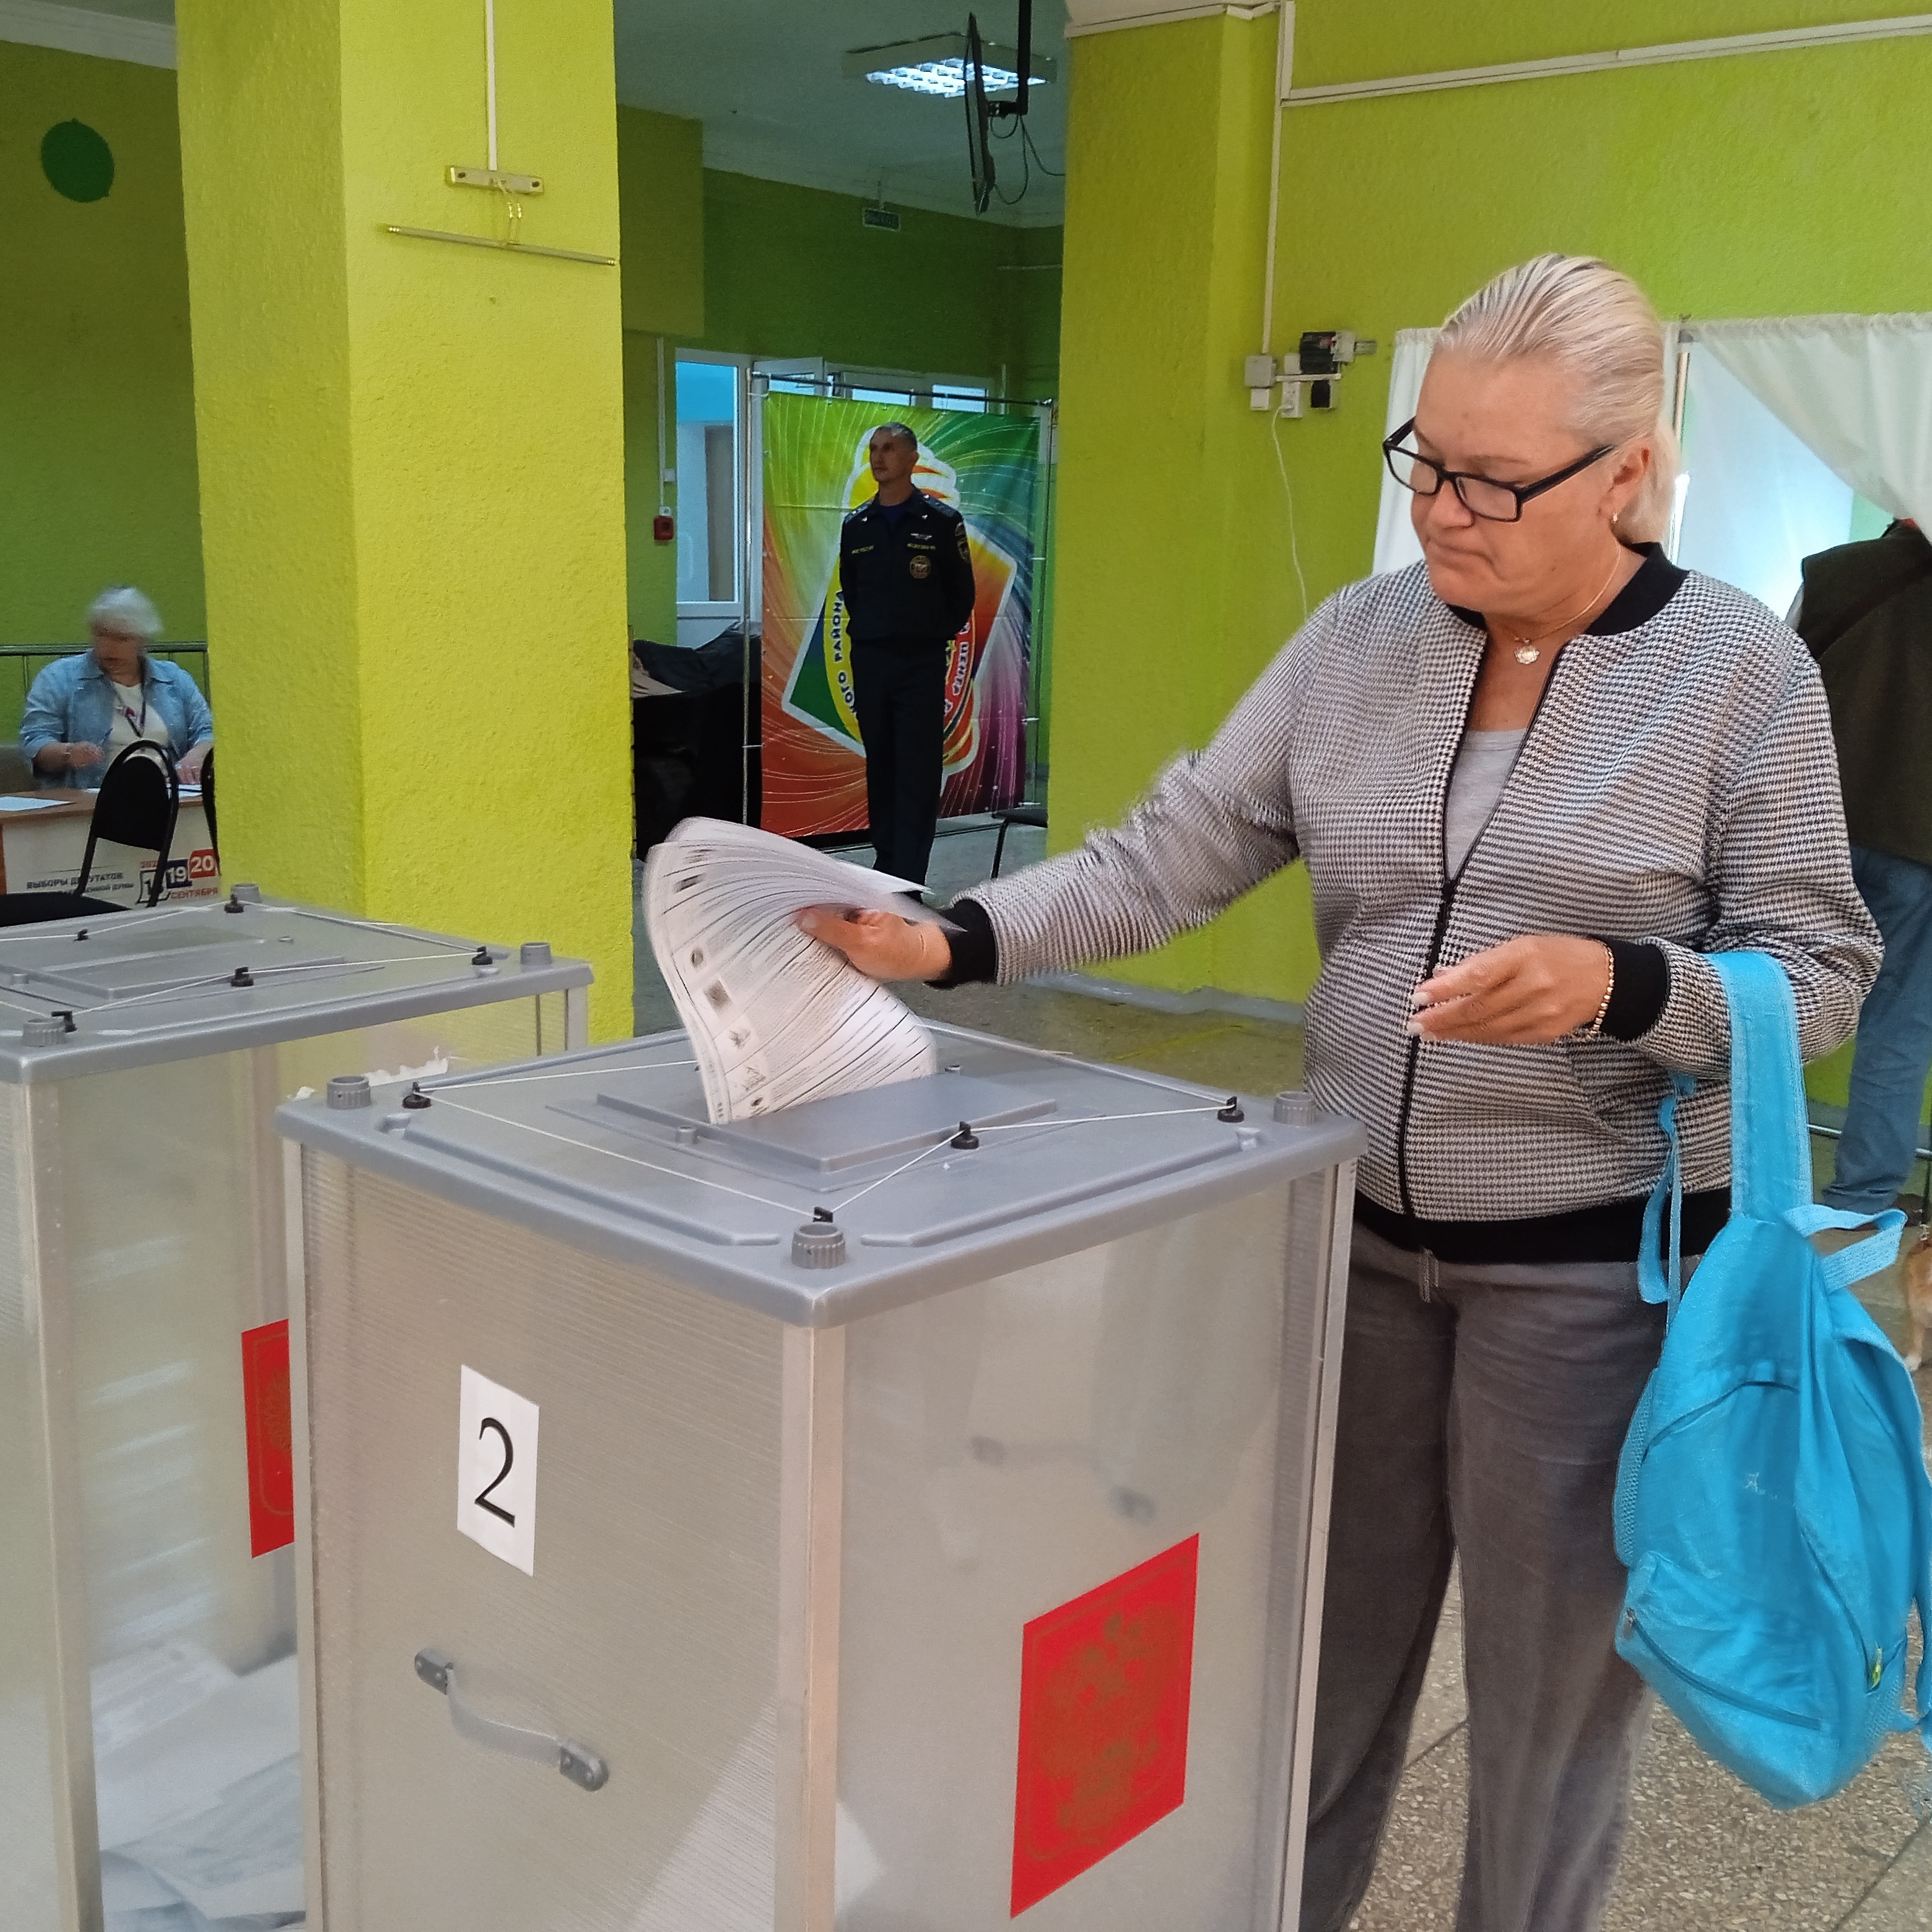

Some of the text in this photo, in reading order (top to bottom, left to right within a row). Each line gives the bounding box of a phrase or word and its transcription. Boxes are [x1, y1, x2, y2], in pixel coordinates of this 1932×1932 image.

[832, 591, 844, 662] РАЙОНА
[191, 855, 214, 872] 20
[167, 866, 186, 883] 19
[27, 878, 67, 889] ВЫБОРЫ
[171, 887, 219, 899] СЕНТЯБРЯ
[474, 1417, 515, 1528] 2
